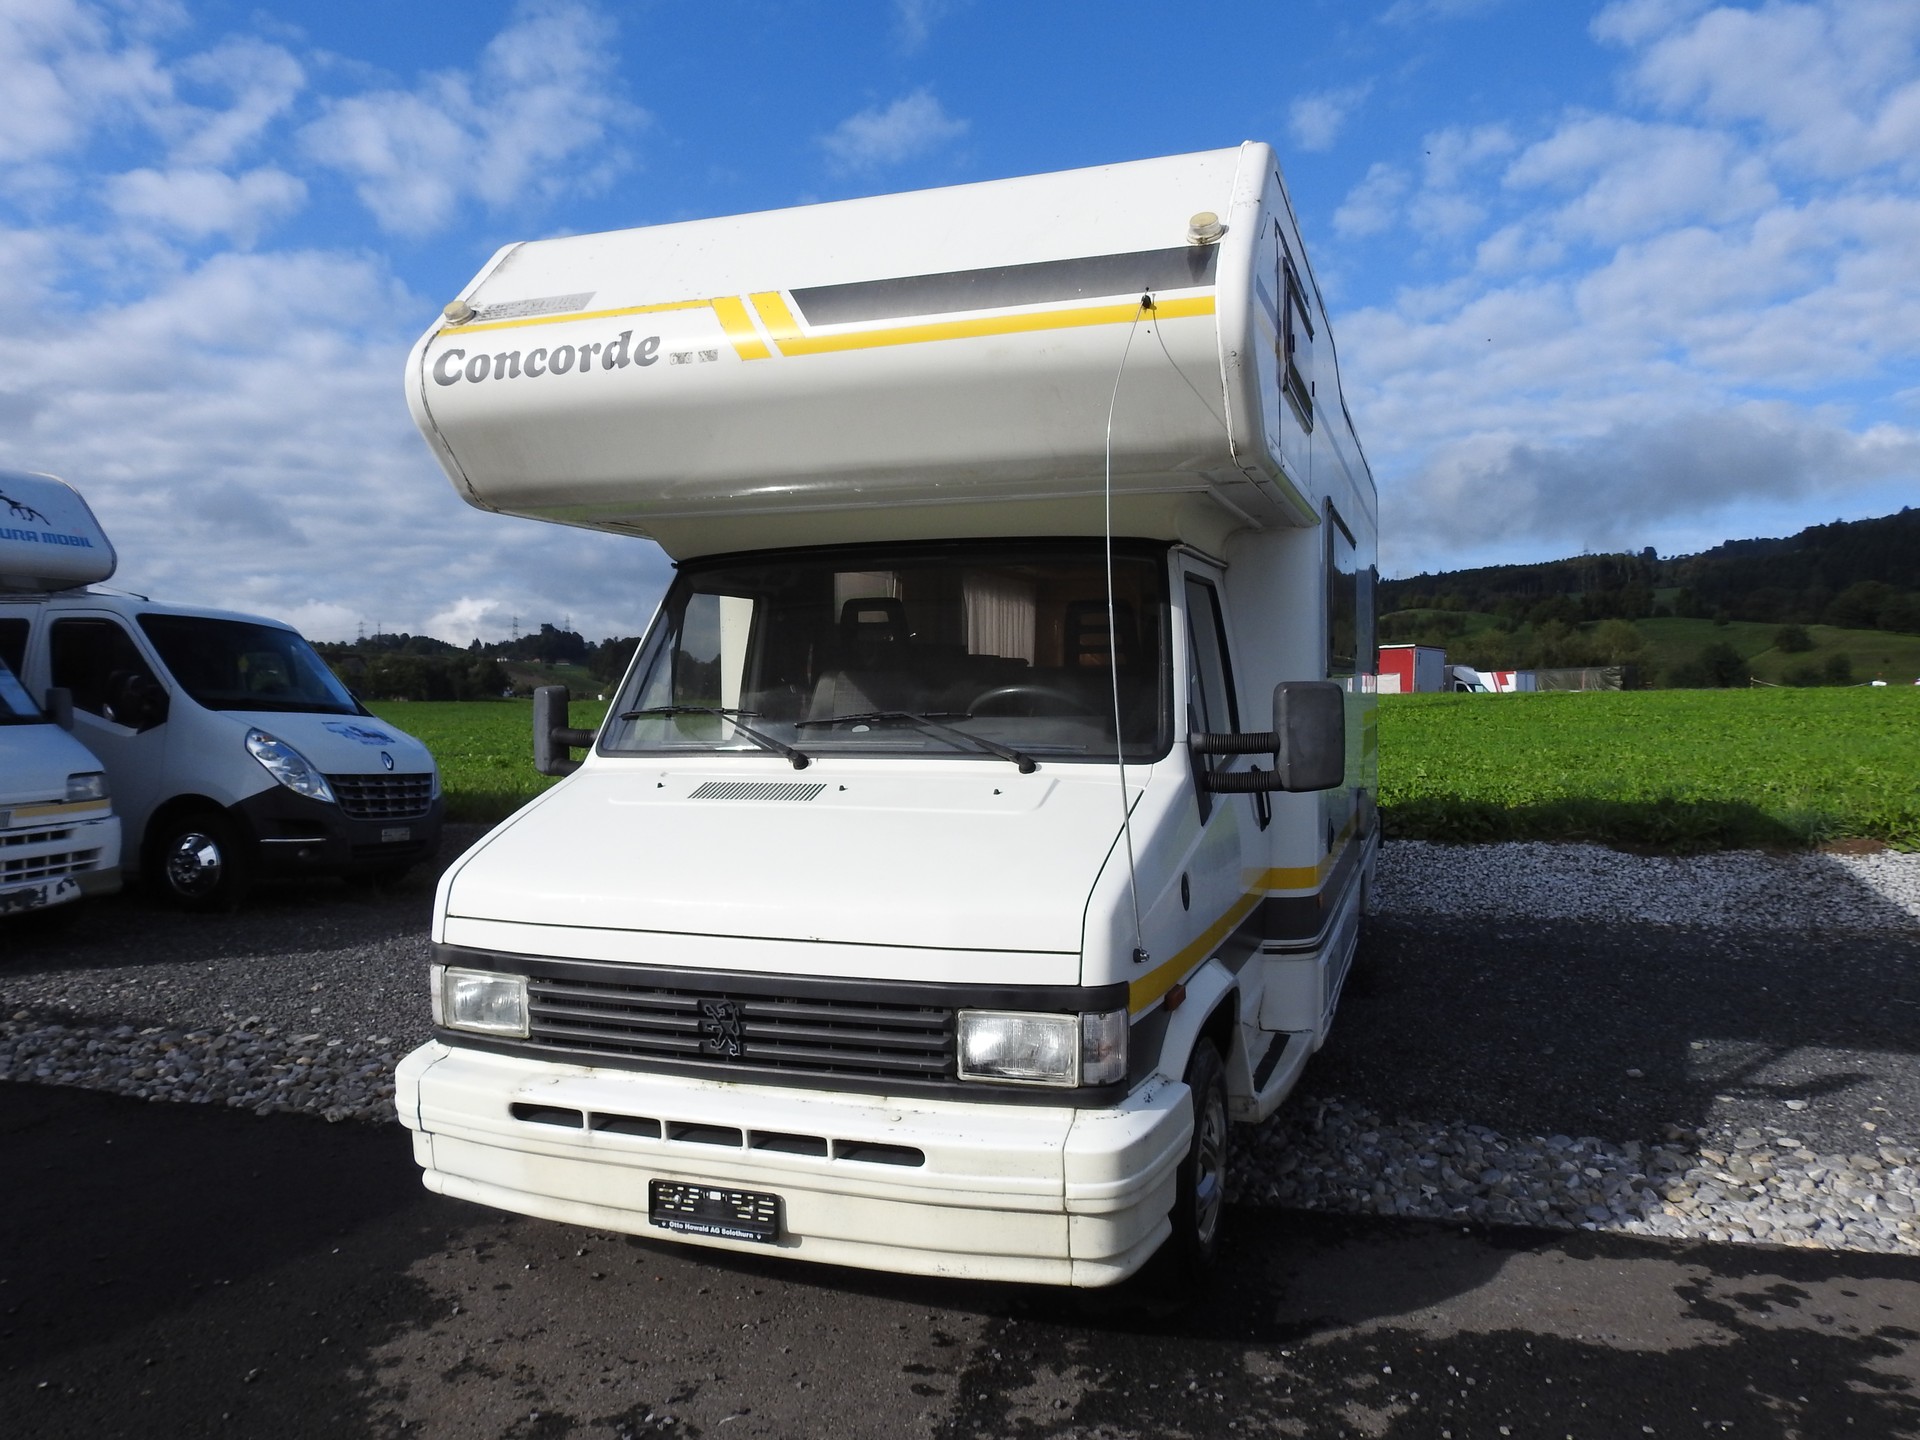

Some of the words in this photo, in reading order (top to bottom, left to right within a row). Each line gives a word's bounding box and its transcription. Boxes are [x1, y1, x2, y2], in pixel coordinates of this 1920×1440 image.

[433, 330, 661, 387] Concorde
[41, 532, 94, 548] MOBIL
[721, 1229, 754, 1239] Solothurn
